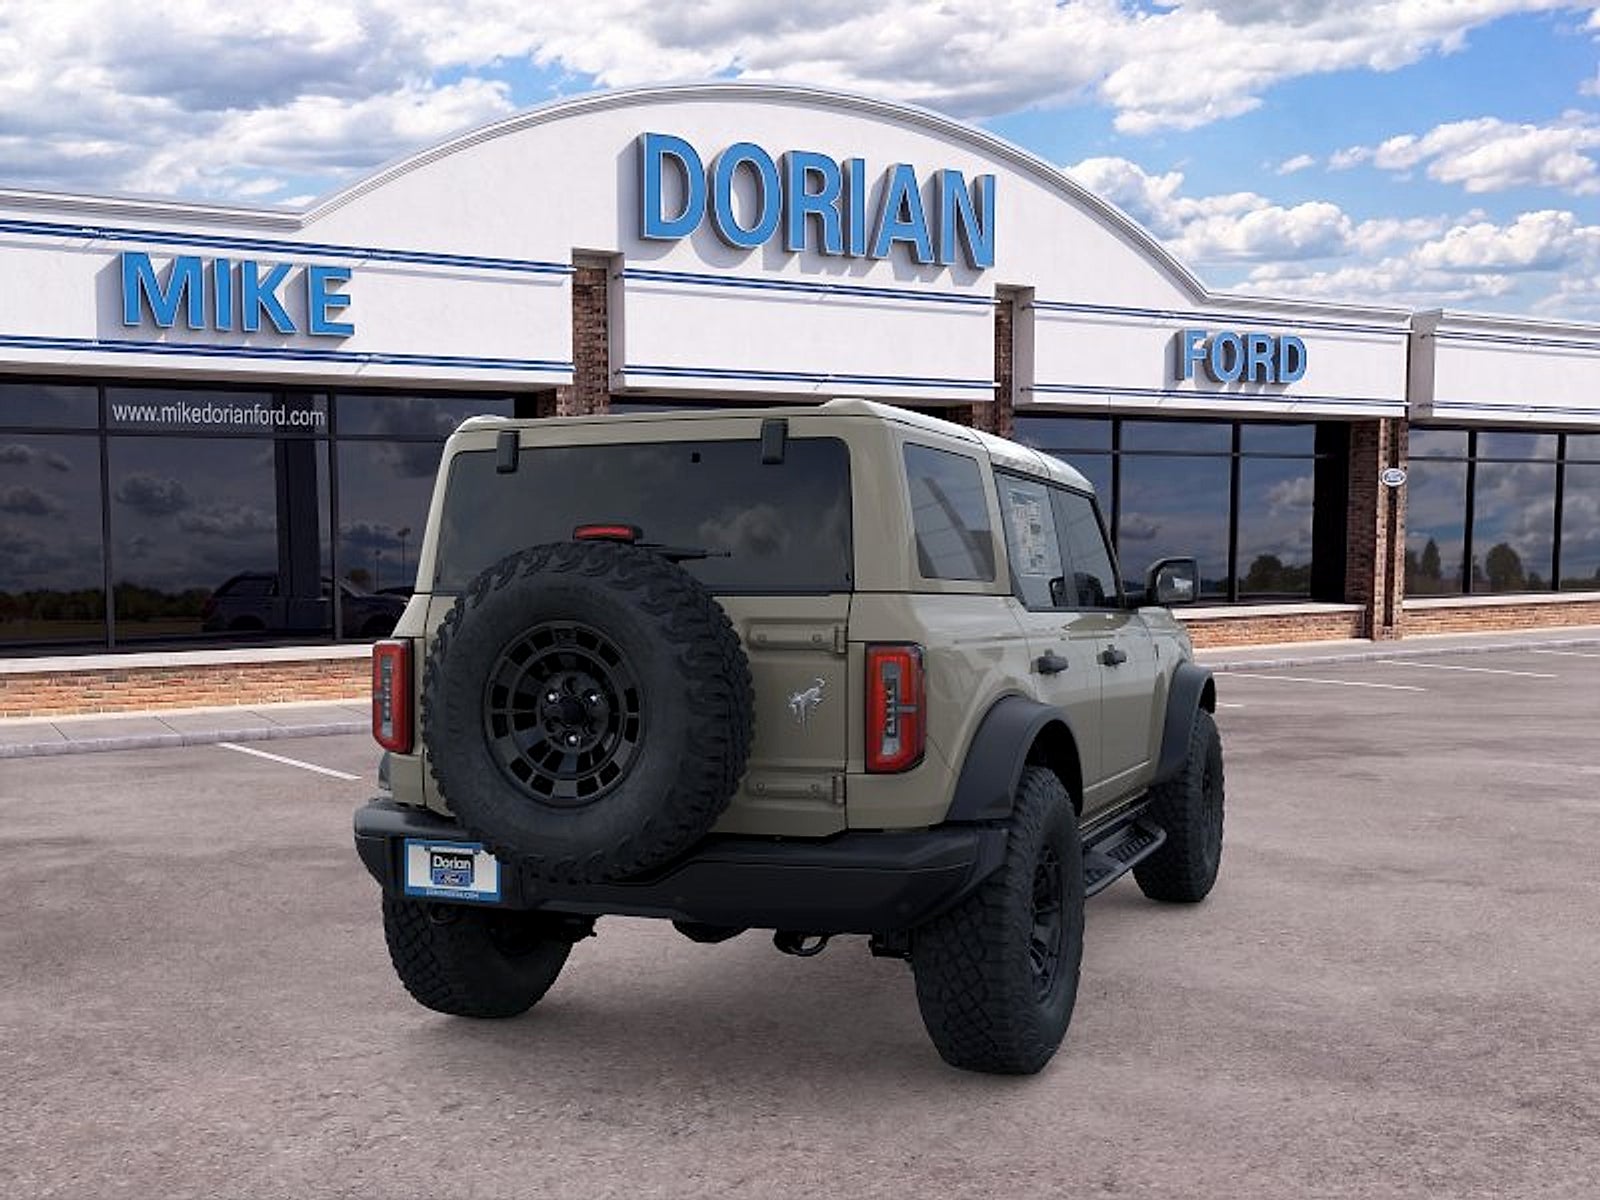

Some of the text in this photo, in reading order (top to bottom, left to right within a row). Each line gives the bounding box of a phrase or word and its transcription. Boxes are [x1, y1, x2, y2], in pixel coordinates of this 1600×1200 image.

[639, 132, 996, 271] DORIAN
[121, 251, 355, 338] MIKE
[1178, 328, 1307, 384] FORD
[112, 401, 326, 427] www.mikedorianford.com
[432, 854, 471, 870] Dorian
